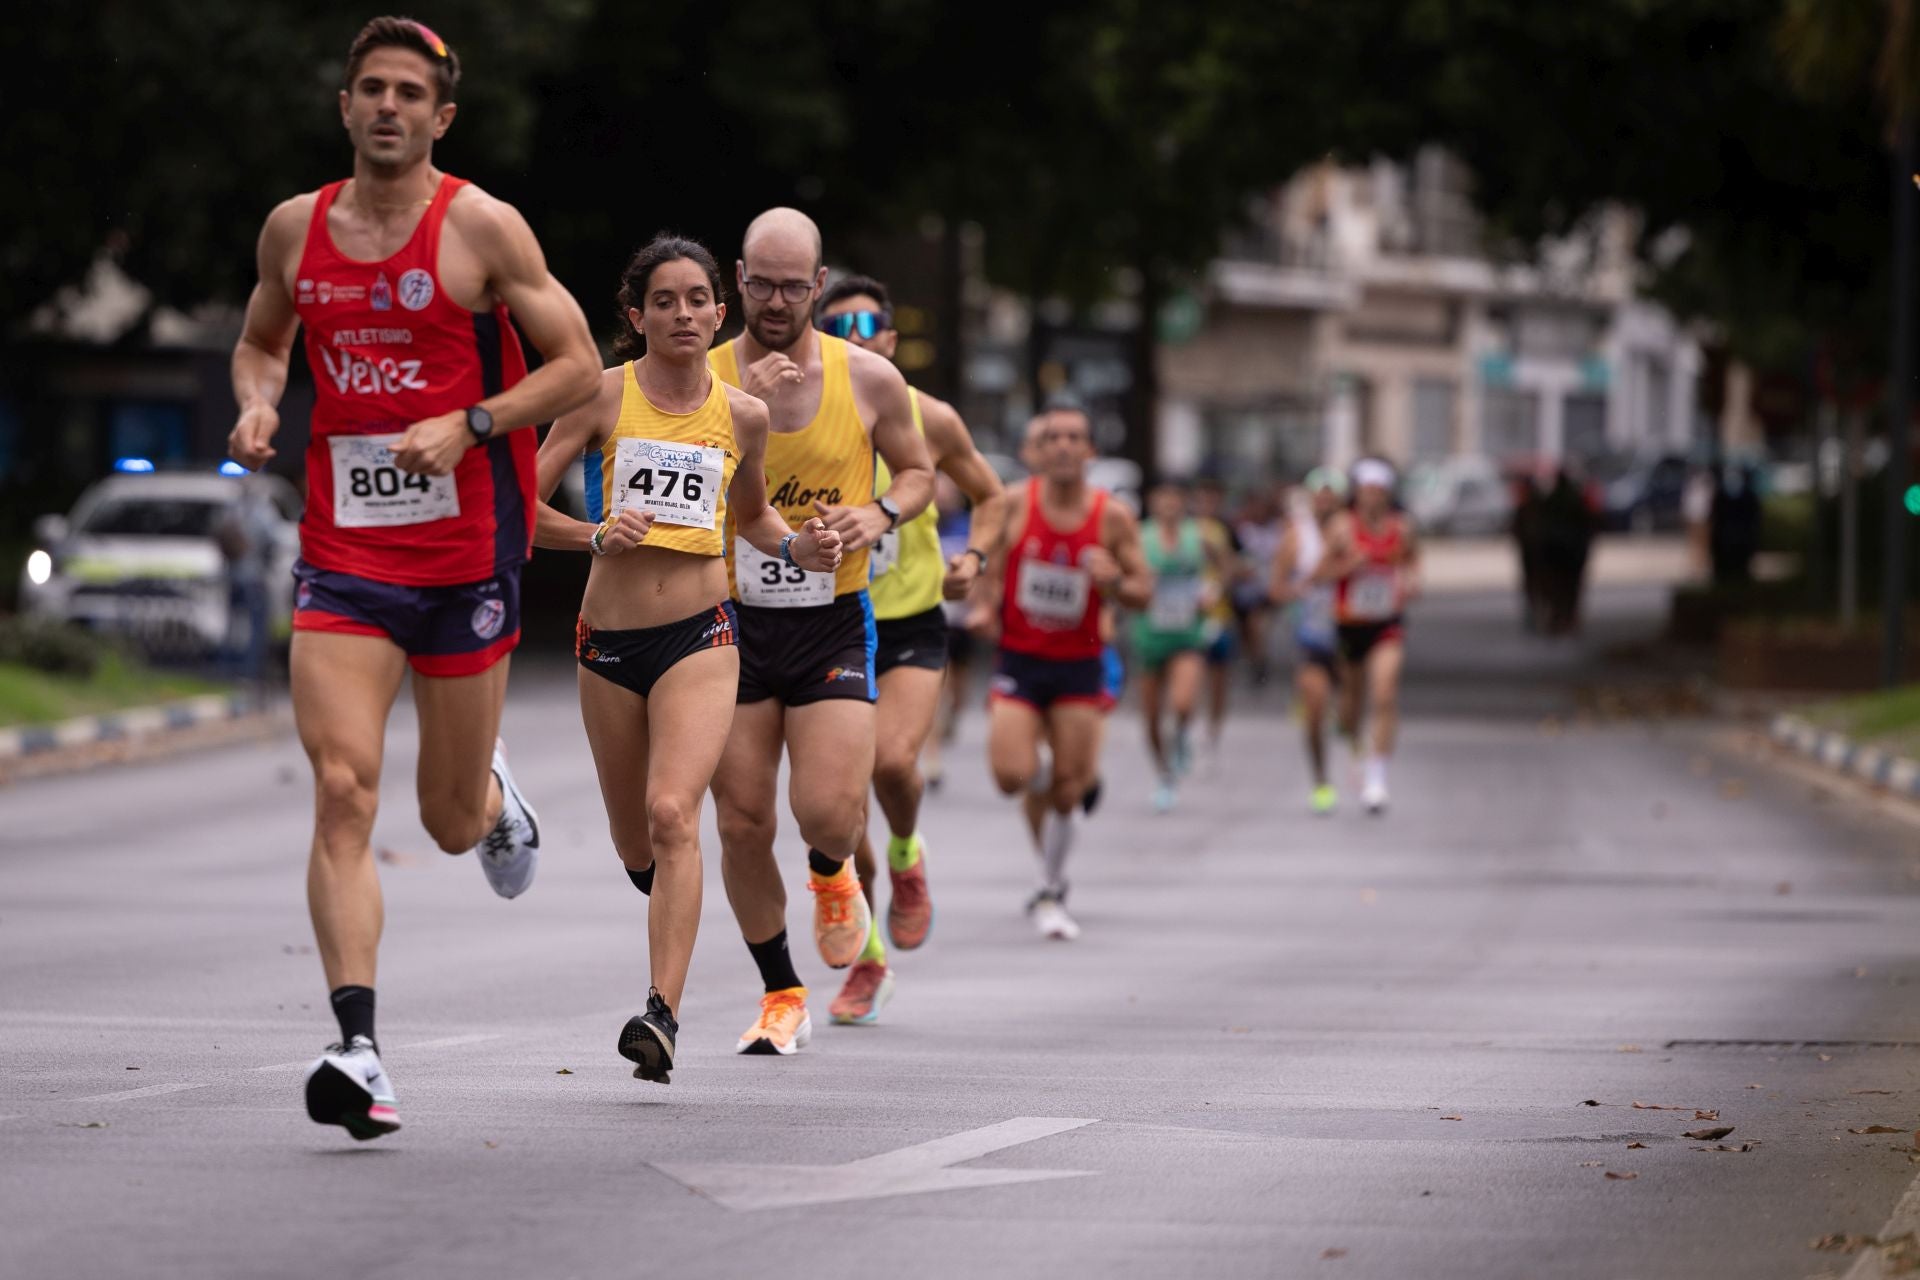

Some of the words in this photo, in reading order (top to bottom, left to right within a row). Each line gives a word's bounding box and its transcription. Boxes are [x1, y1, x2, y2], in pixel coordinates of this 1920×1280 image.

[333, 328, 413, 346] ATLETISMO
[351, 467, 431, 497] 804
[628, 468, 704, 501] 476
[769, 475, 842, 508] Álora
[760, 561, 806, 585] 33
